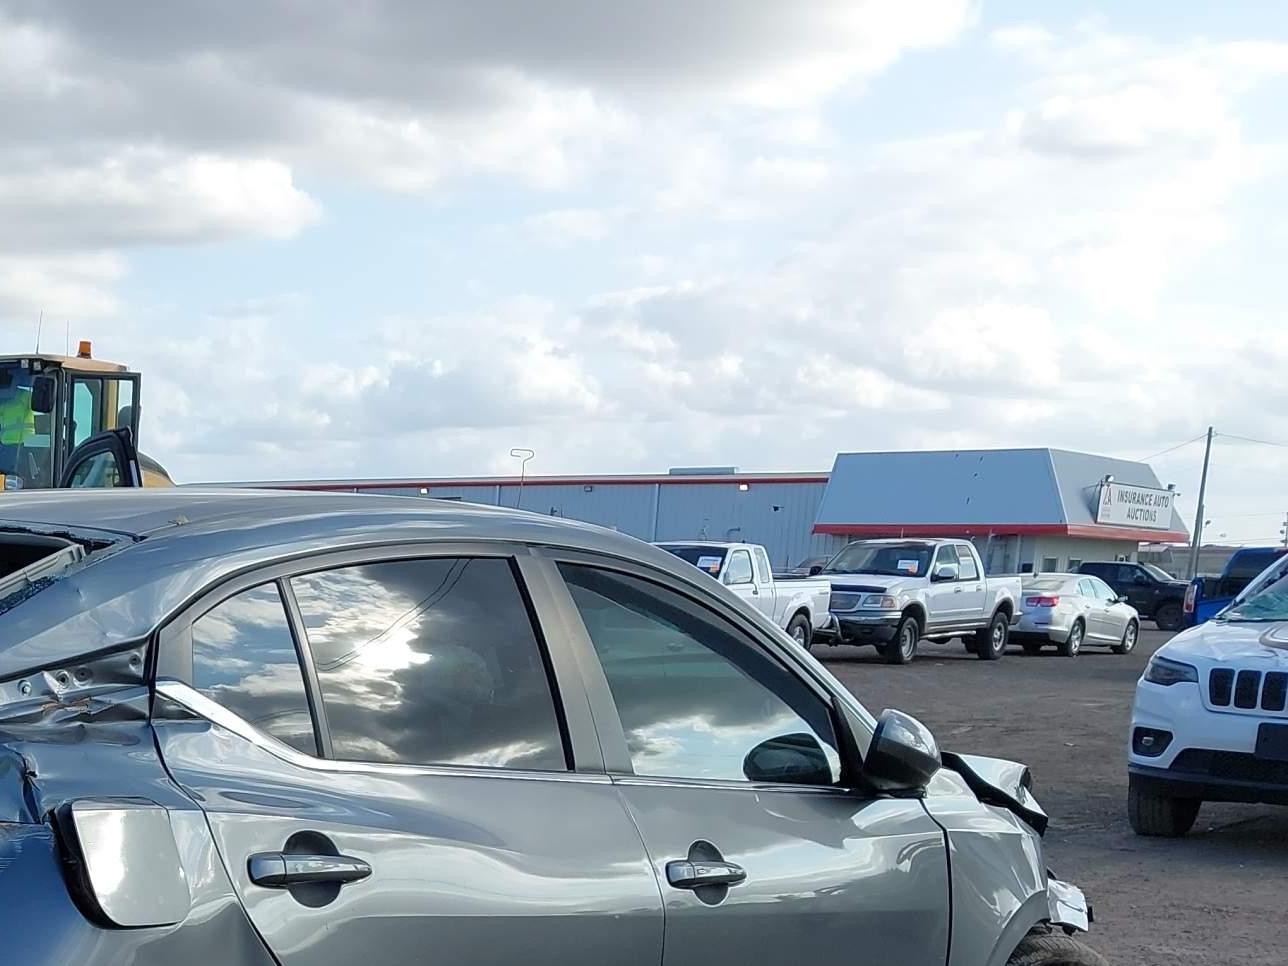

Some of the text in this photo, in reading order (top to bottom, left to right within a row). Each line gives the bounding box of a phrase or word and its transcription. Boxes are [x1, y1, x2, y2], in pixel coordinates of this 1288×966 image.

[1117, 490, 1152, 506] INSURANCE
[1153, 494, 1169, 508] AUTO
[1127, 507, 1157, 522] AUCTIONS
